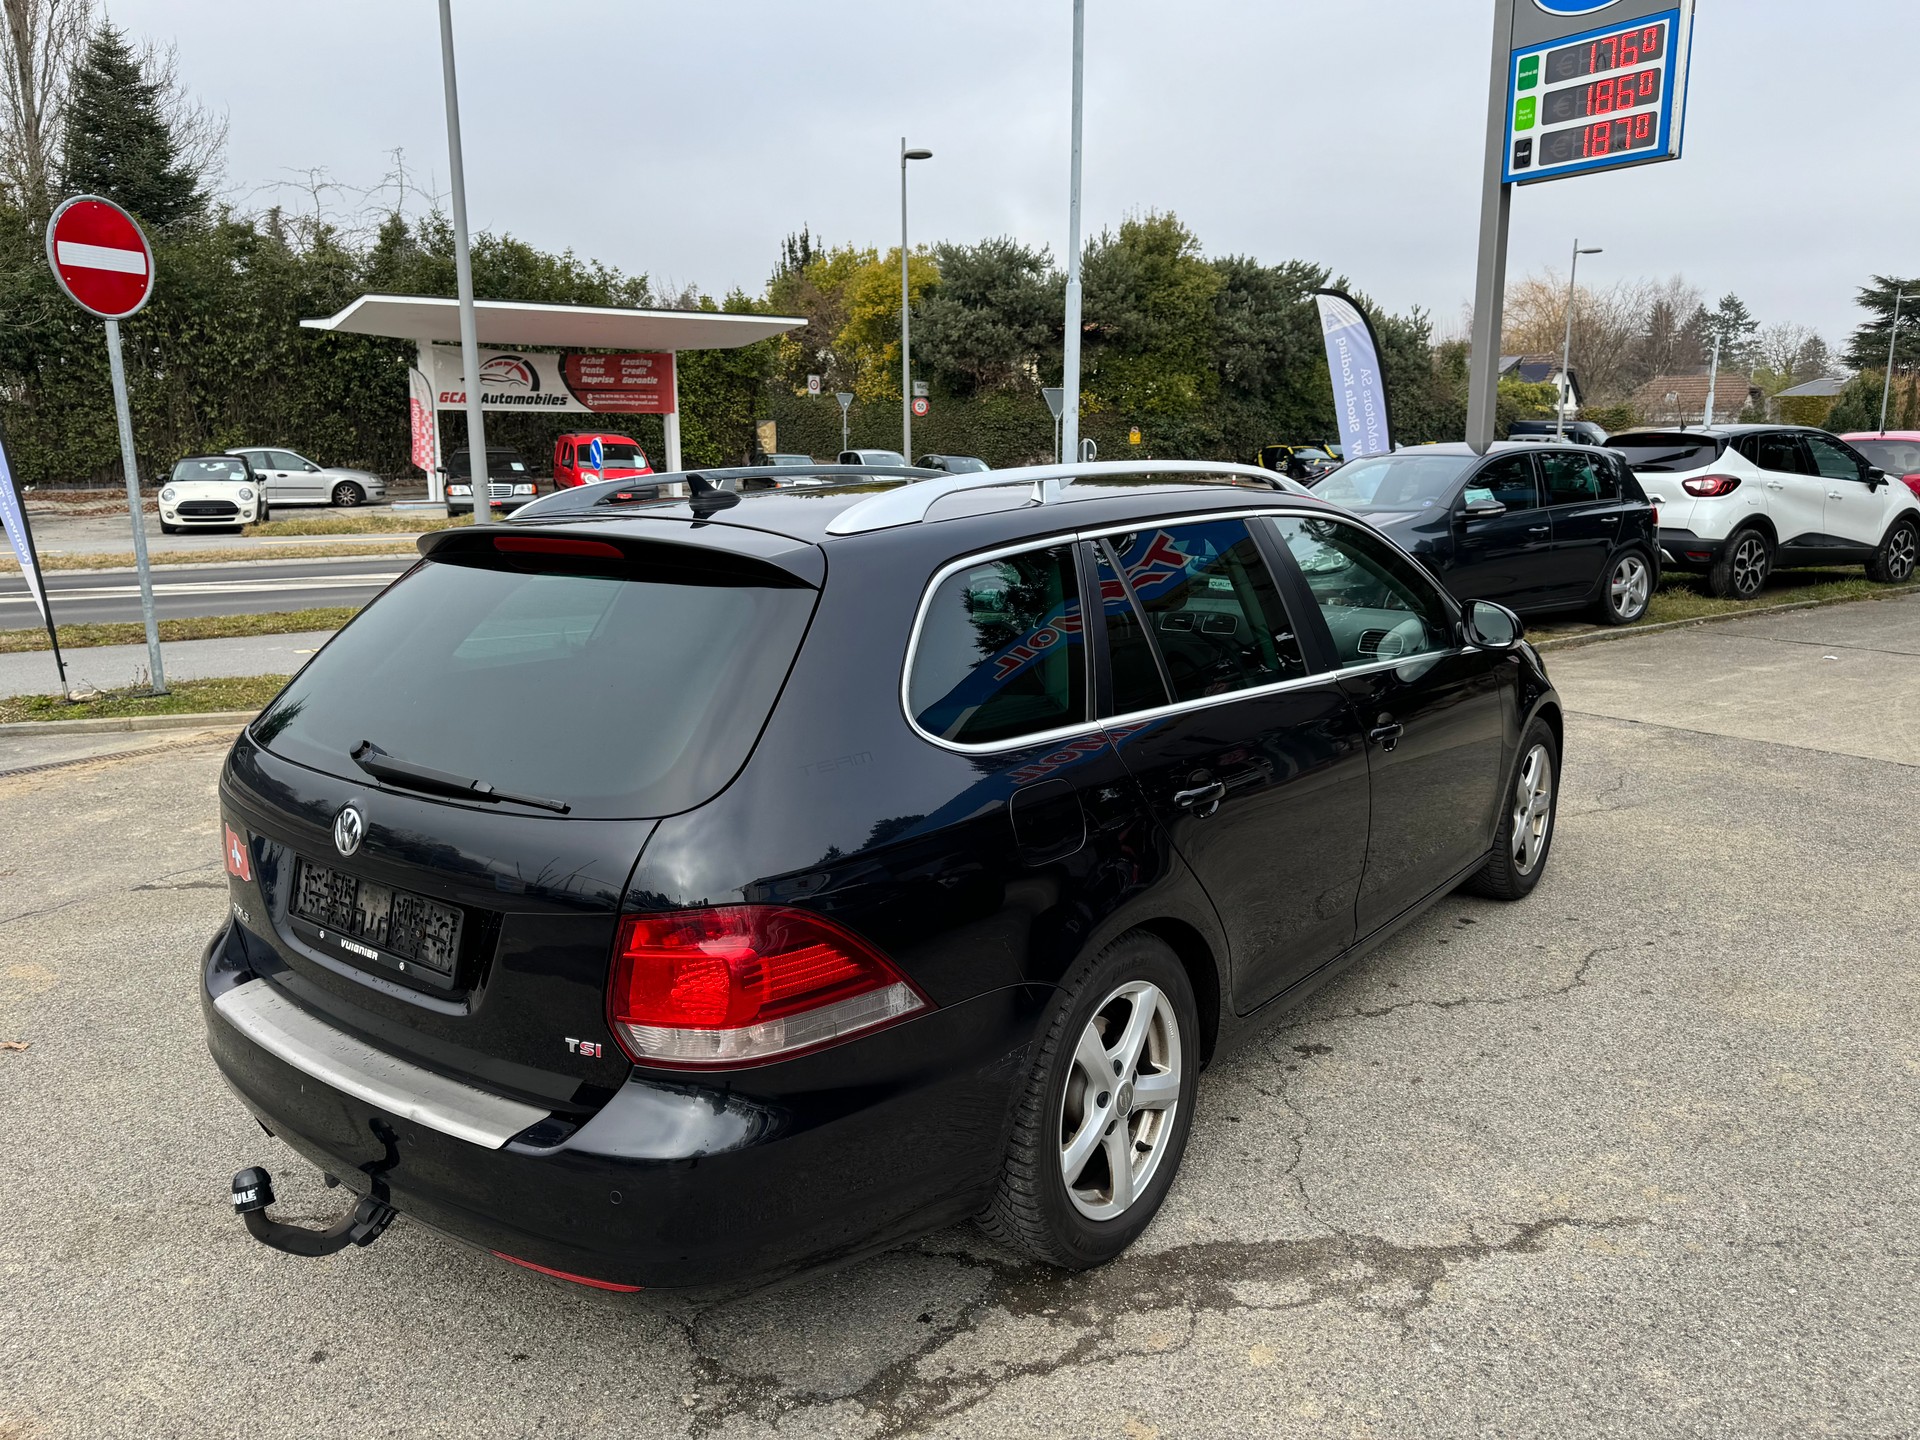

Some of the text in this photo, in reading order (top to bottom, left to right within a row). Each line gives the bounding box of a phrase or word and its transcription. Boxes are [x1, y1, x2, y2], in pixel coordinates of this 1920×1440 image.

[1589, 27, 1658, 74] 1760
[1586, 71, 1653, 116] 1860
[1583, 114, 1650, 157] 1870
[580, 357, 605, 365] Achat
[621, 358, 653, 367] Leasing
[581, 366, 605, 374] Vente
[581, 375, 615, 384] Reprise
[622, 376, 658, 384] Garantie
[439, 392, 567, 406] GCA Automobiles
[341, 938, 378, 961] VUIGNIER
[564, 1037, 602, 1059] TSI
